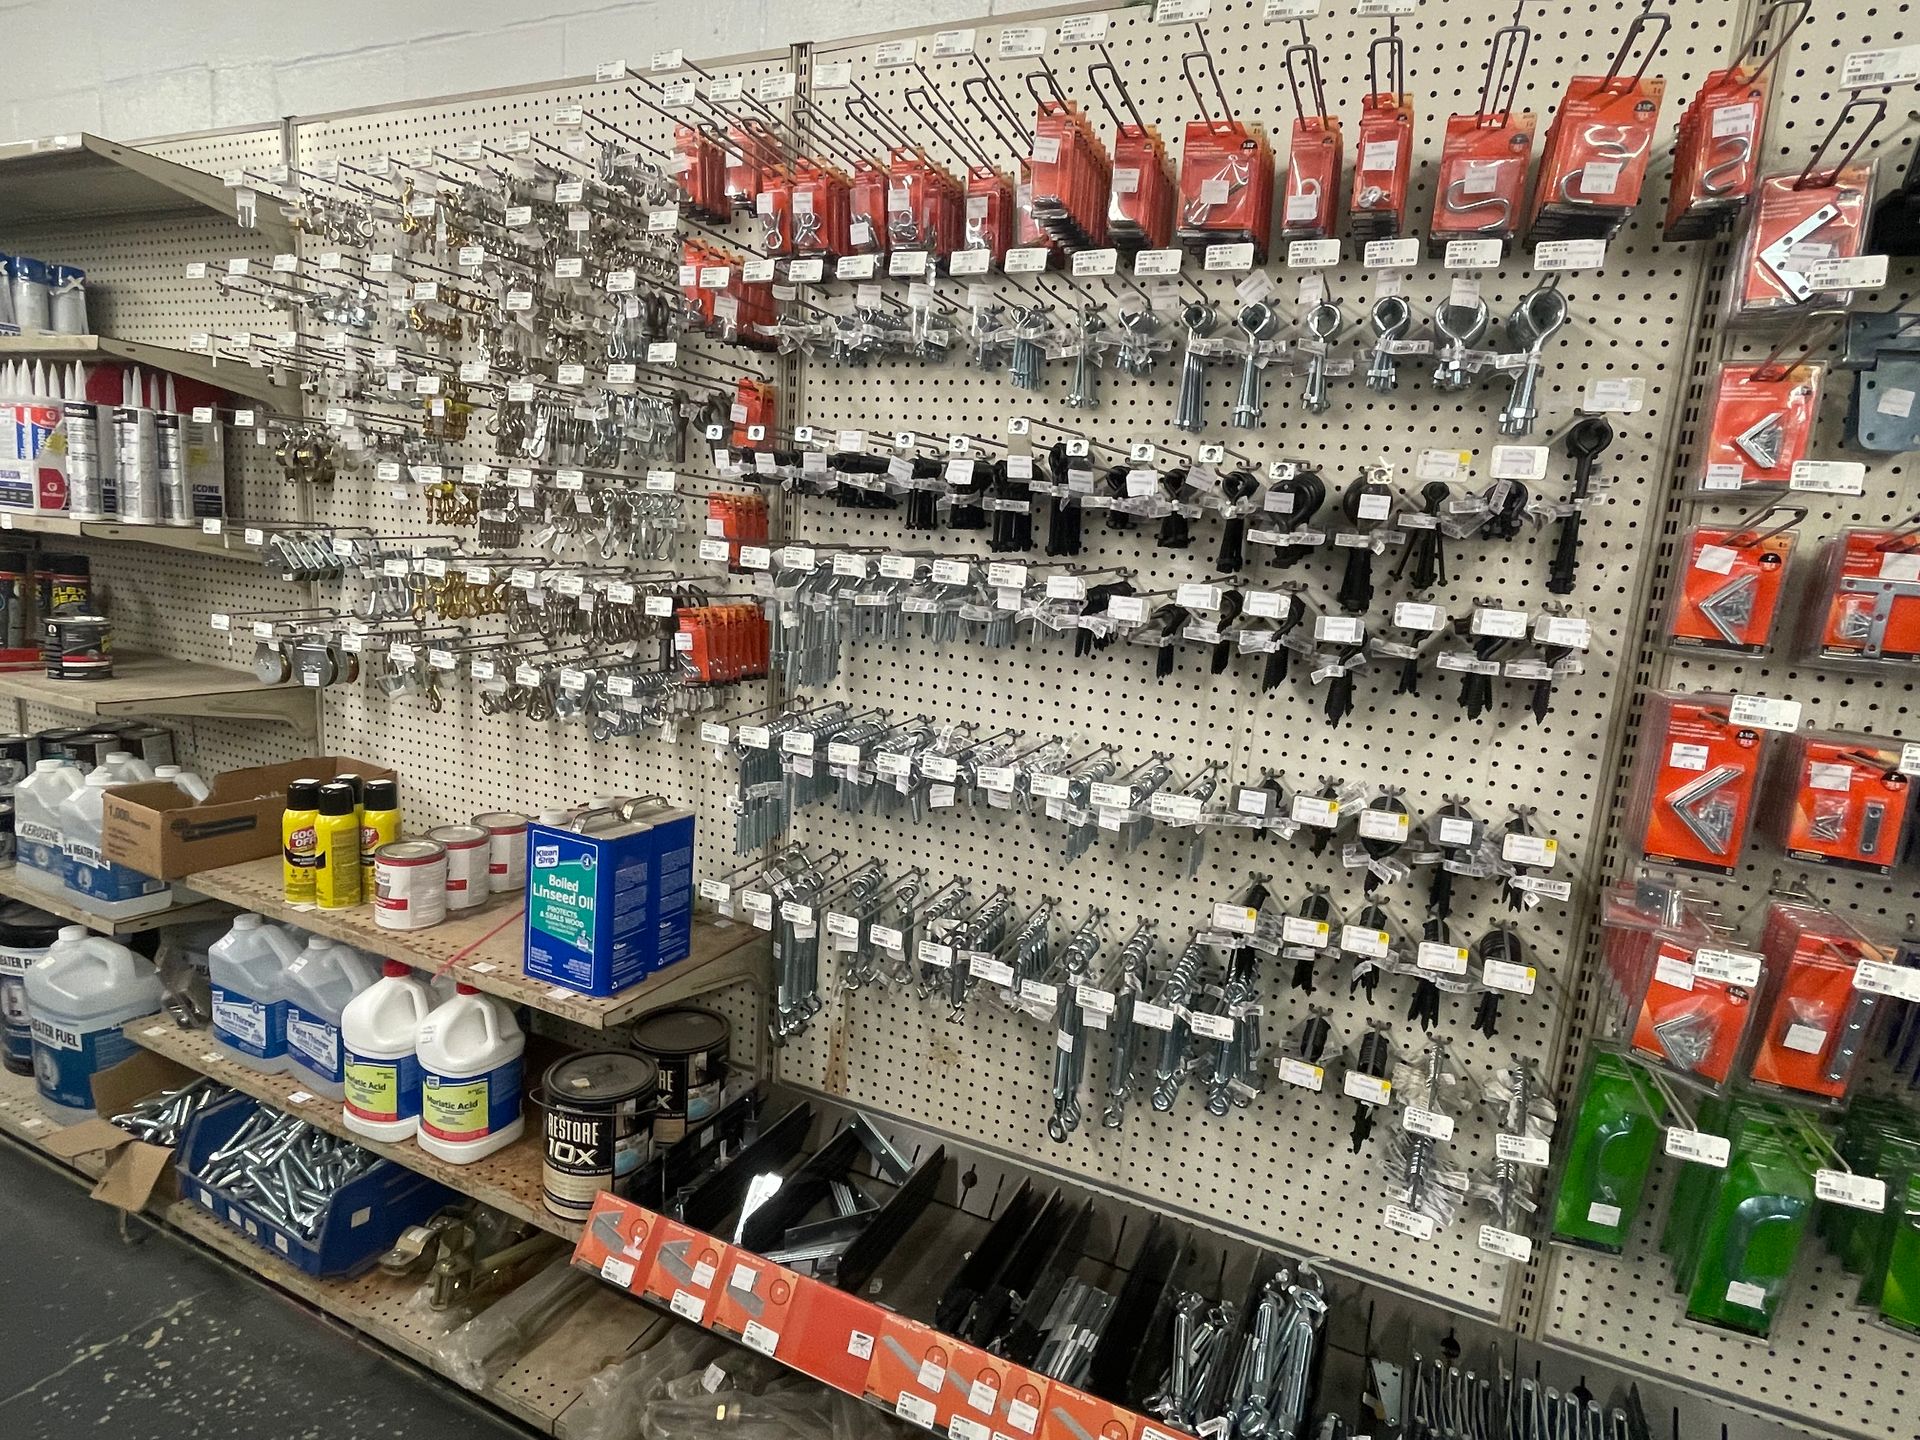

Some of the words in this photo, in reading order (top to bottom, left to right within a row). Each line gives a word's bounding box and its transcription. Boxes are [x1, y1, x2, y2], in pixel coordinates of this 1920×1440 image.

[53, 586, 87, 597] FLEX
[21, 822, 59, 843] KEROSENE
[292, 829, 315, 840] GOO
[536, 849, 558, 858] Klean
[549, 874, 579, 892] Boiled
[533, 882, 576, 905] Linseed
[578, 895, 593, 910] Oil
[547, 904, 578, 919] PROTECTS
[0, 954, 22, 969] EATER
[55, 1028, 79, 1048] FUEL
[368, 1081, 386, 1091] Acid
[457, 1099, 478, 1110] Acid
[548, 1112, 599, 1146] RESTORE
